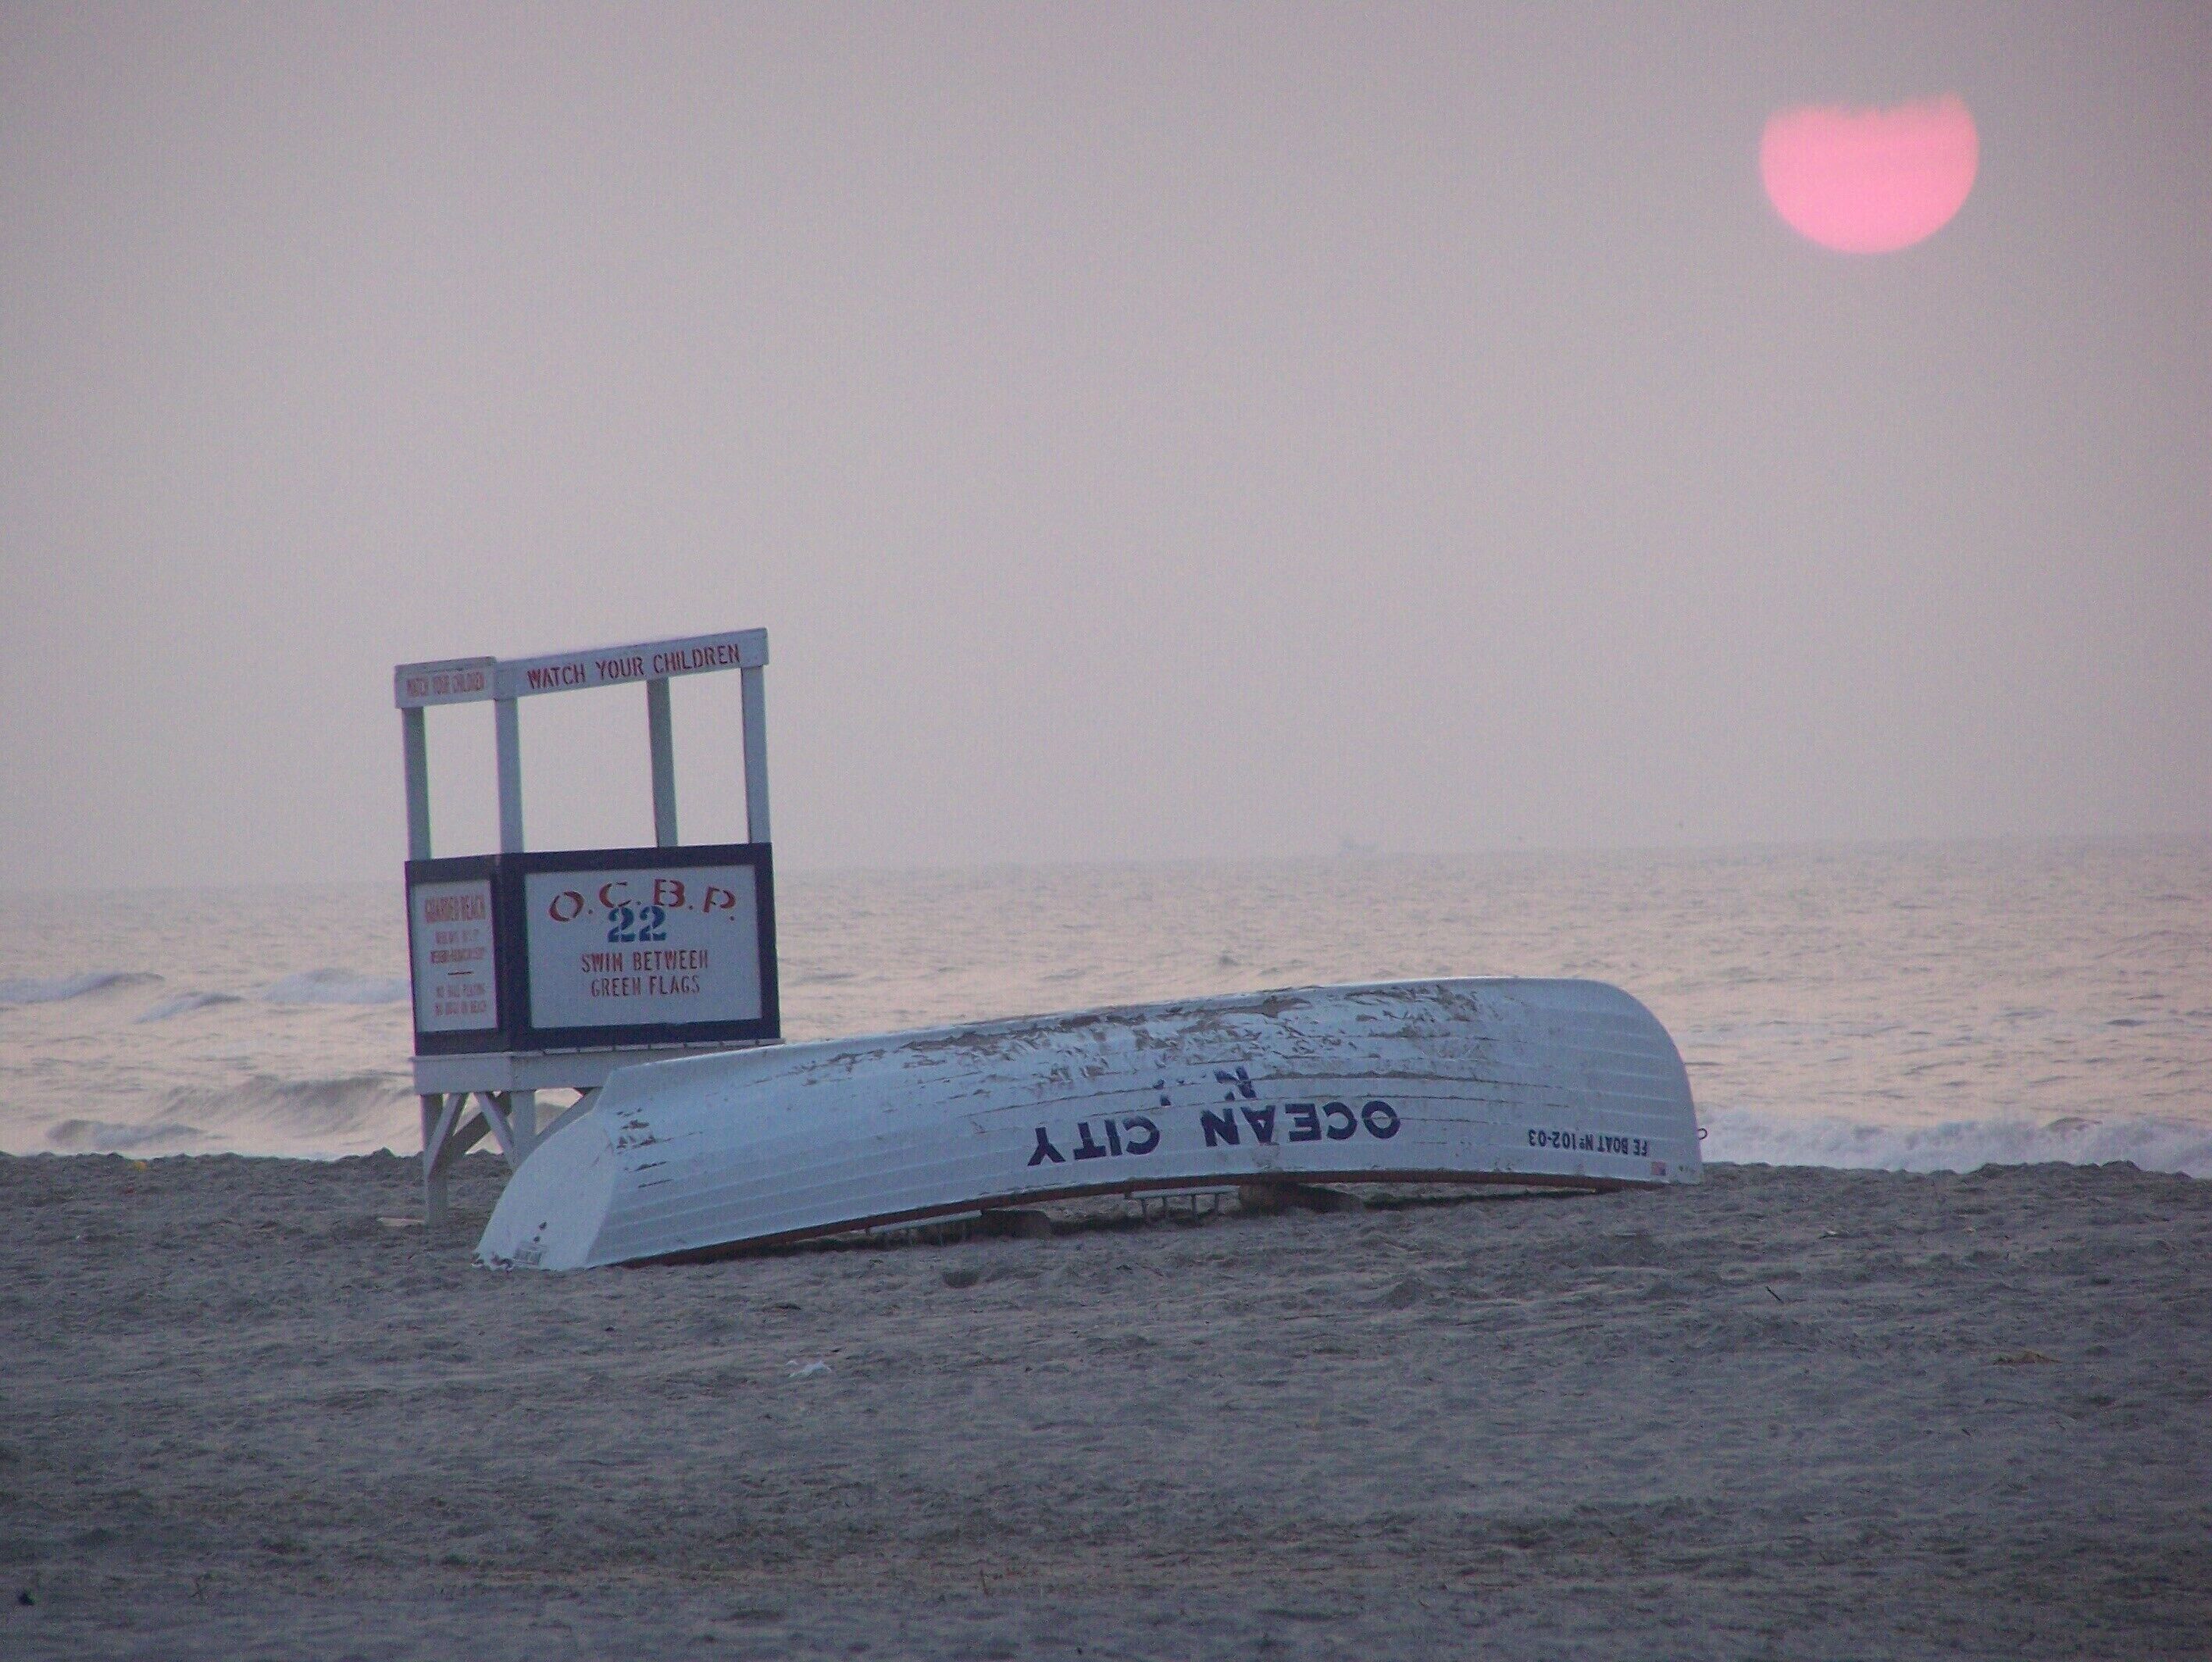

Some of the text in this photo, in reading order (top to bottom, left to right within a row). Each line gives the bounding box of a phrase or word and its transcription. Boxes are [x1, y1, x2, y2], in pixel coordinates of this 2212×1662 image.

[526, 643, 740, 690] WATCH YOUR CHILDREN
[607, 905, 667, 943] 22
[581, 949, 708, 973] SWIM BETWEEN
[590, 975, 701, 997] GREEN FLAGS
[1026, 1100, 1402, 1167] OCEAN CITY
[1597, 1135, 1629, 1155] BOAT
